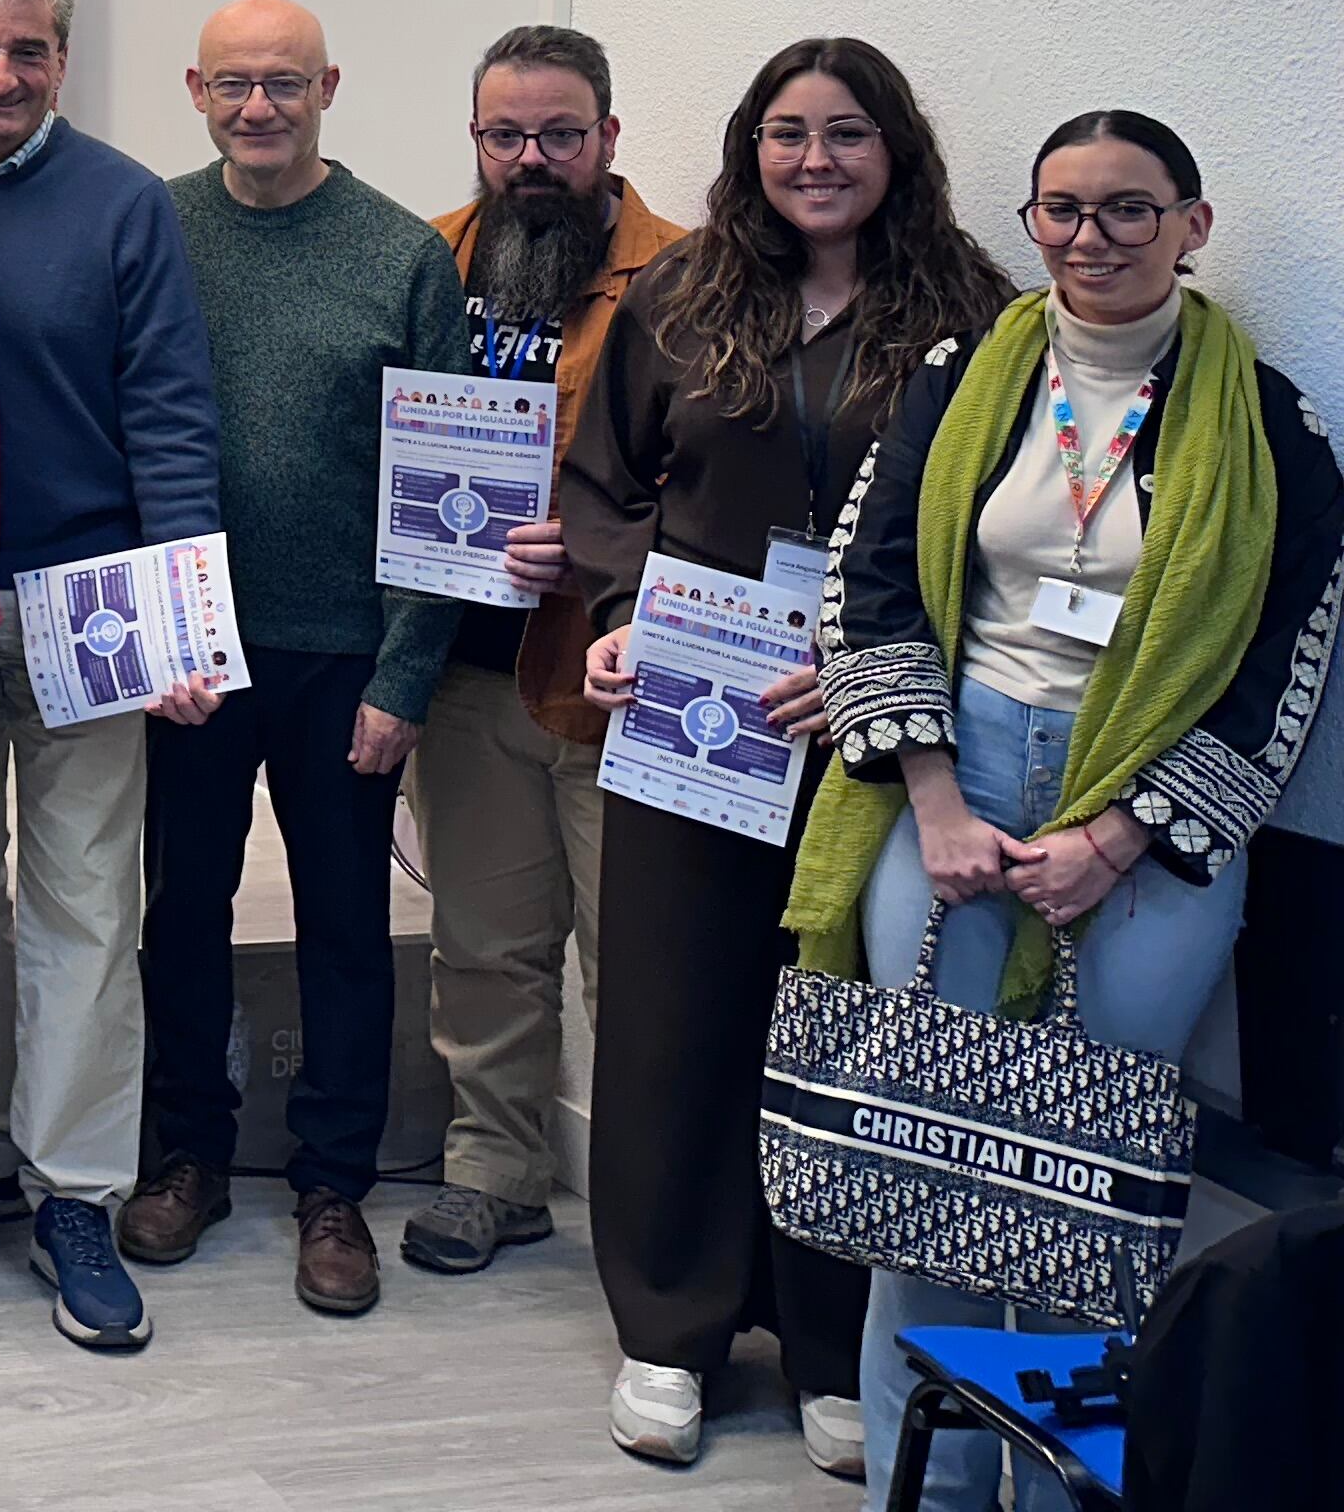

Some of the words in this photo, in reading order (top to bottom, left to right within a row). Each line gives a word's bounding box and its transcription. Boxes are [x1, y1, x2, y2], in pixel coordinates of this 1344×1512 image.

[400, 406, 441, 418] ¡UNIDAS
[442, 411, 462, 420] POR
[464, 414, 478, 423] LA
[479, 415, 534, 427] IGUALDAD!
[657, 597, 703, 616] ¡UNIDAS
[704, 609, 727, 623] POR
[729, 616, 744, 628] LA
[746, 620, 808, 645] IGUALDAD!
[672, 638, 681, 646] LA
[682, 640, 705, 652] LUCHA
[706, 647, 721, 656] POR
[722, 651, 731, 659] LA
[768, 664, 778, 673] DE
[675, 759, 685, 768] TE
[687, 763, 699, 772] LO
[852, 1108, 1023, 1177] CHRISTIAN
[1033, 1154, 1113, 1202] DIOR
[949, 1162, 987, 1179] PARIS
